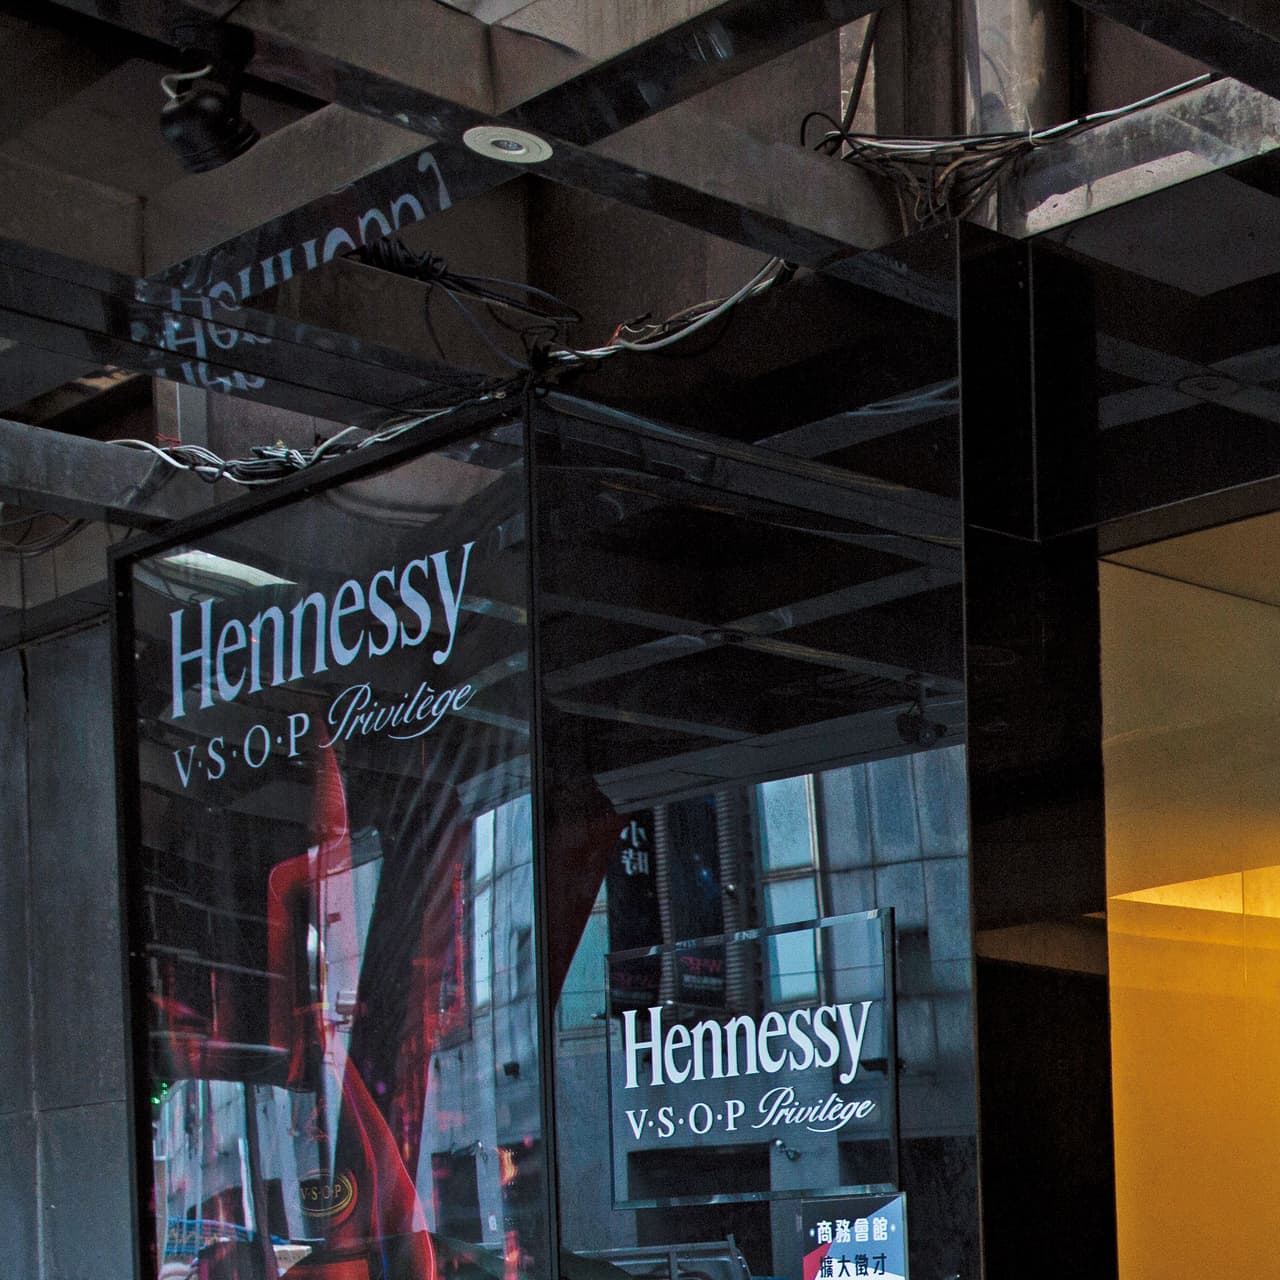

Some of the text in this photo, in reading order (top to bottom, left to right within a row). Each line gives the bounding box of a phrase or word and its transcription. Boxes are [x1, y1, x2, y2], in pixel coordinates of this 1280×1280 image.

[170, 541, 476, 719] Hennessy
[318, 682, 478, 748] Privilège
[622, 1000, 873, 1089] Hennessy
[751, 1086, 876, 1133] Privilège
[817, 1217, 888, 1244] 商務會館
[820, 1253, 887, 1278] 擴大徵才
